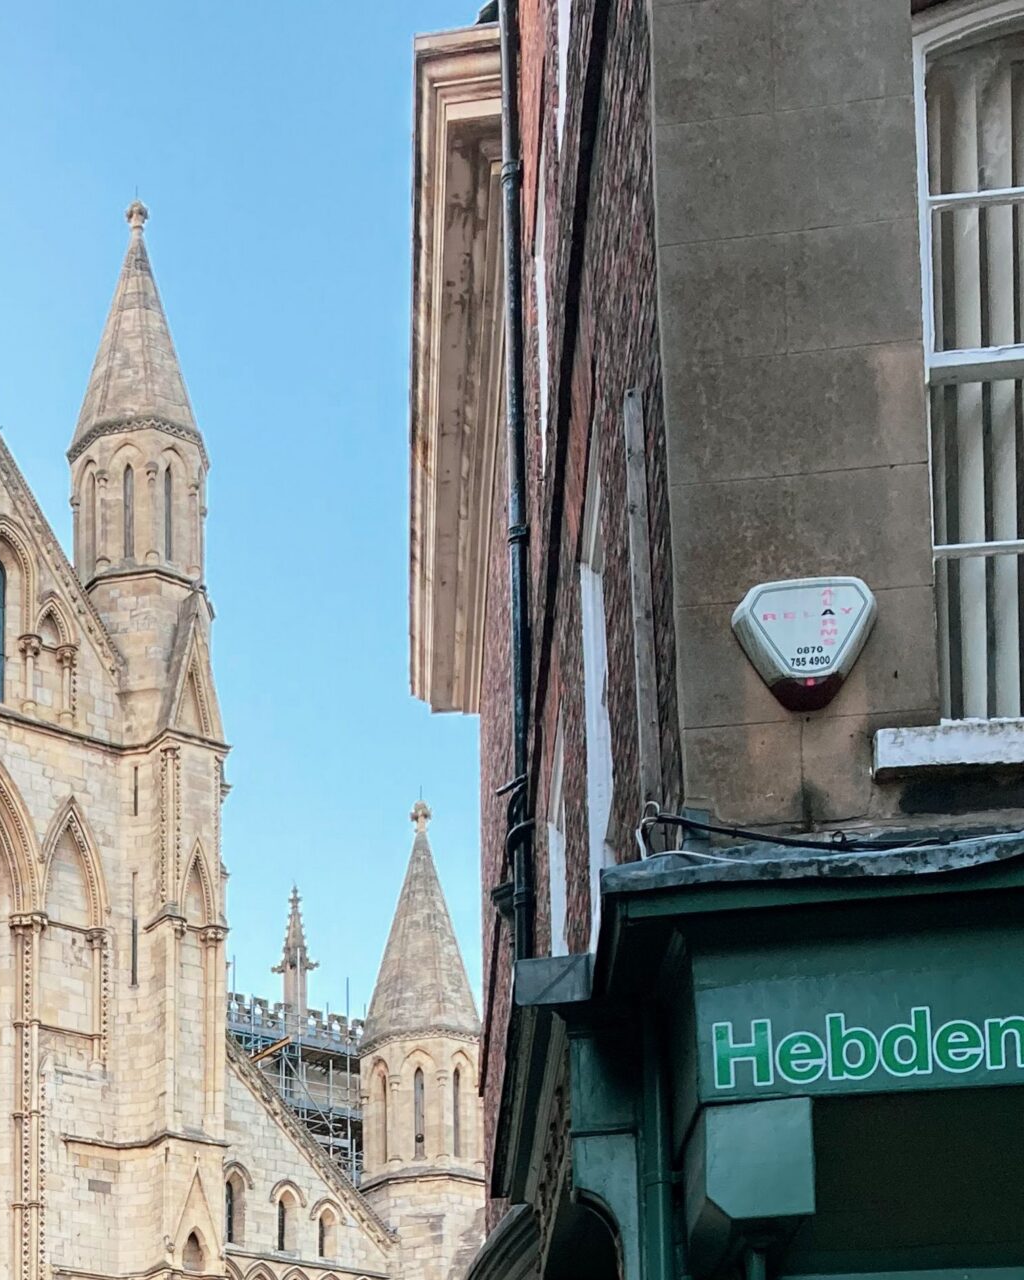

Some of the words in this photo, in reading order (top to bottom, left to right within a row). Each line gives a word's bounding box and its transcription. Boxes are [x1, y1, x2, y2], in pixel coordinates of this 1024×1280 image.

[796, 645, 824, 655] 0870
[791, 657, 807, 667] 755
[808, 655, 831, 666] 4900
[712, 1005, 1024, 1090] Hebden
